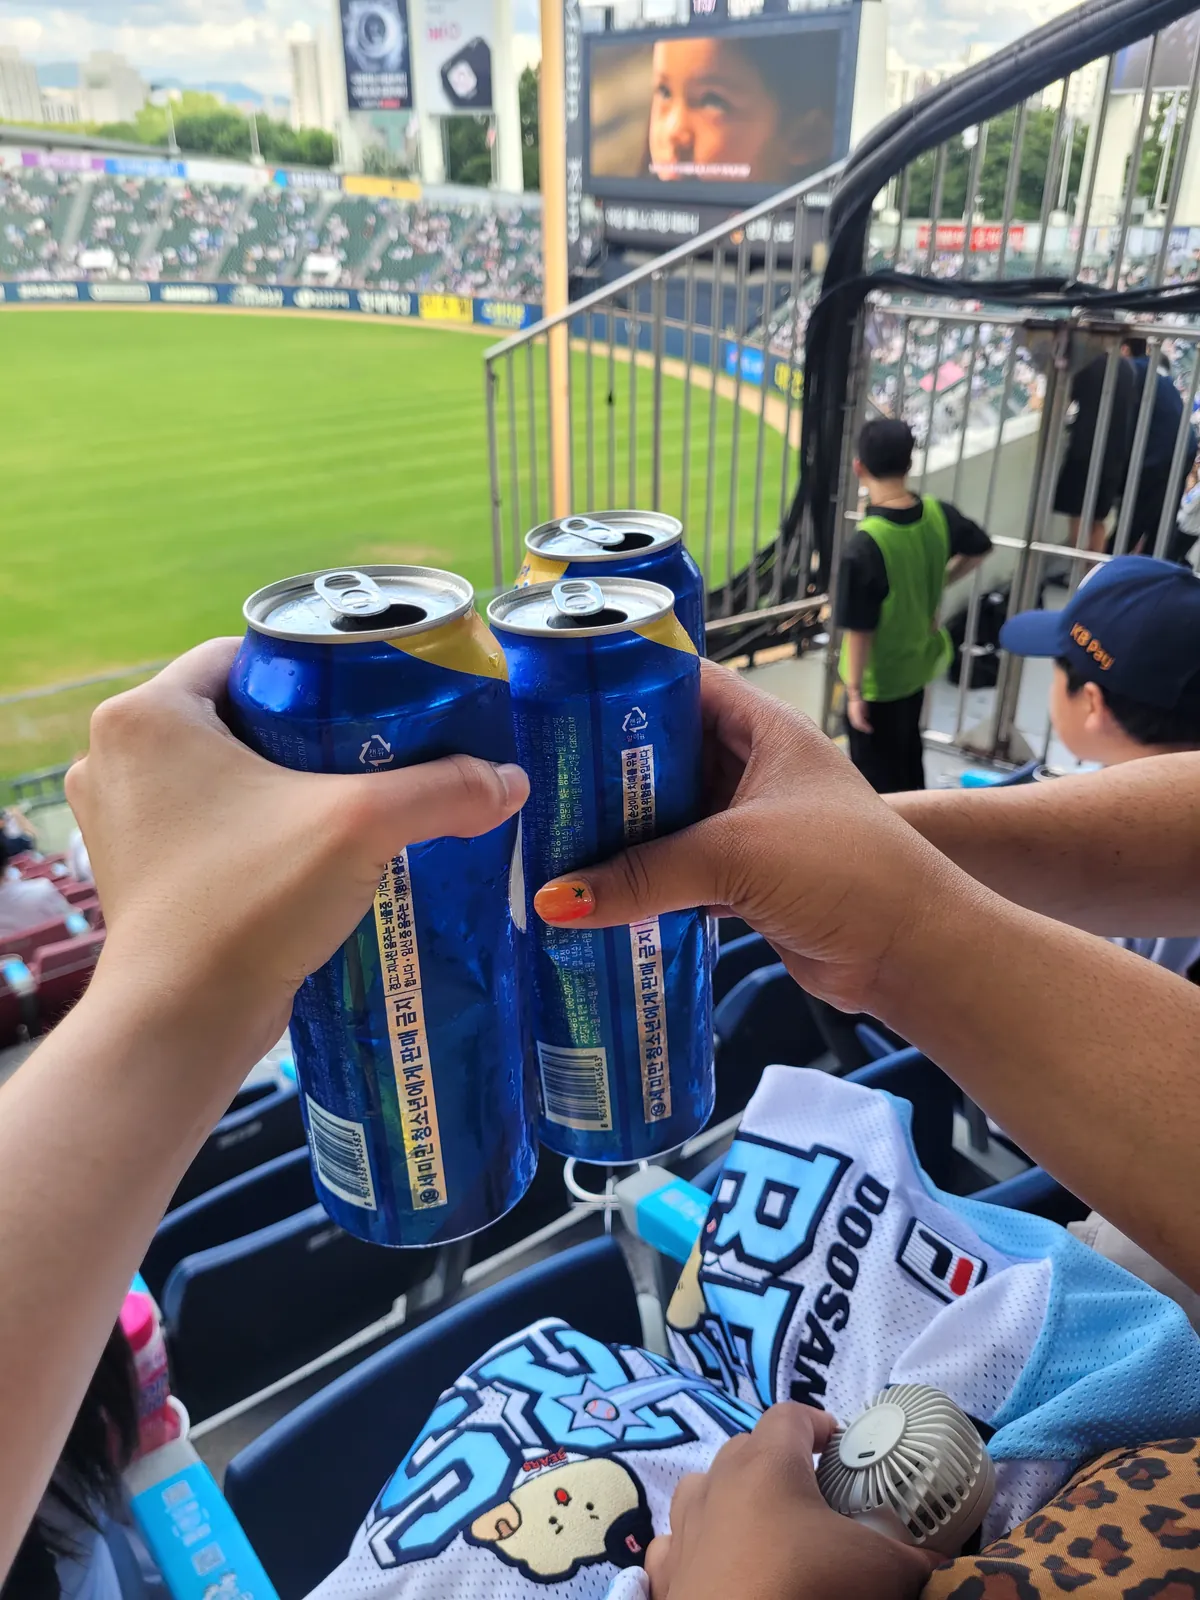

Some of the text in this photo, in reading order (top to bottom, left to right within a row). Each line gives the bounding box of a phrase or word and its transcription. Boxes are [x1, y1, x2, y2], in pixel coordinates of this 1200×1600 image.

[1069, 622, 1116, 671] KB Pay
[566, 716, 578, 748] cass.co.kr
[626, 752, 637, 767] 유발
[640, 749, 651, 782] 높입니다
[626, 768, 638, 790] 치매를
[640, 782, 652, 806] 위험을
[627, 790, 639, 818] 손상이나
[379, 898, 394, 925] 뇌졸중,
[390, 854, 417, 988] 합니다 임신 중 음주는 기형아 출생
[382, 926, 398, 950] 음주는
[636, 928, 656, 959] 금지
[384, 950, 399, 973] 지나친
[638, 961, 658, 990] 판매
[388, 974, 402, 992] 경고:
[393, 996, 418, 1027] 금지
[642, 992, 663, 1060] 청소년에게
[397, 1028, 422, 1062] 판매
[403, 1064, 432, 1141] 청소년에게
[788, 1173, 891, 1411] DOOSAN
